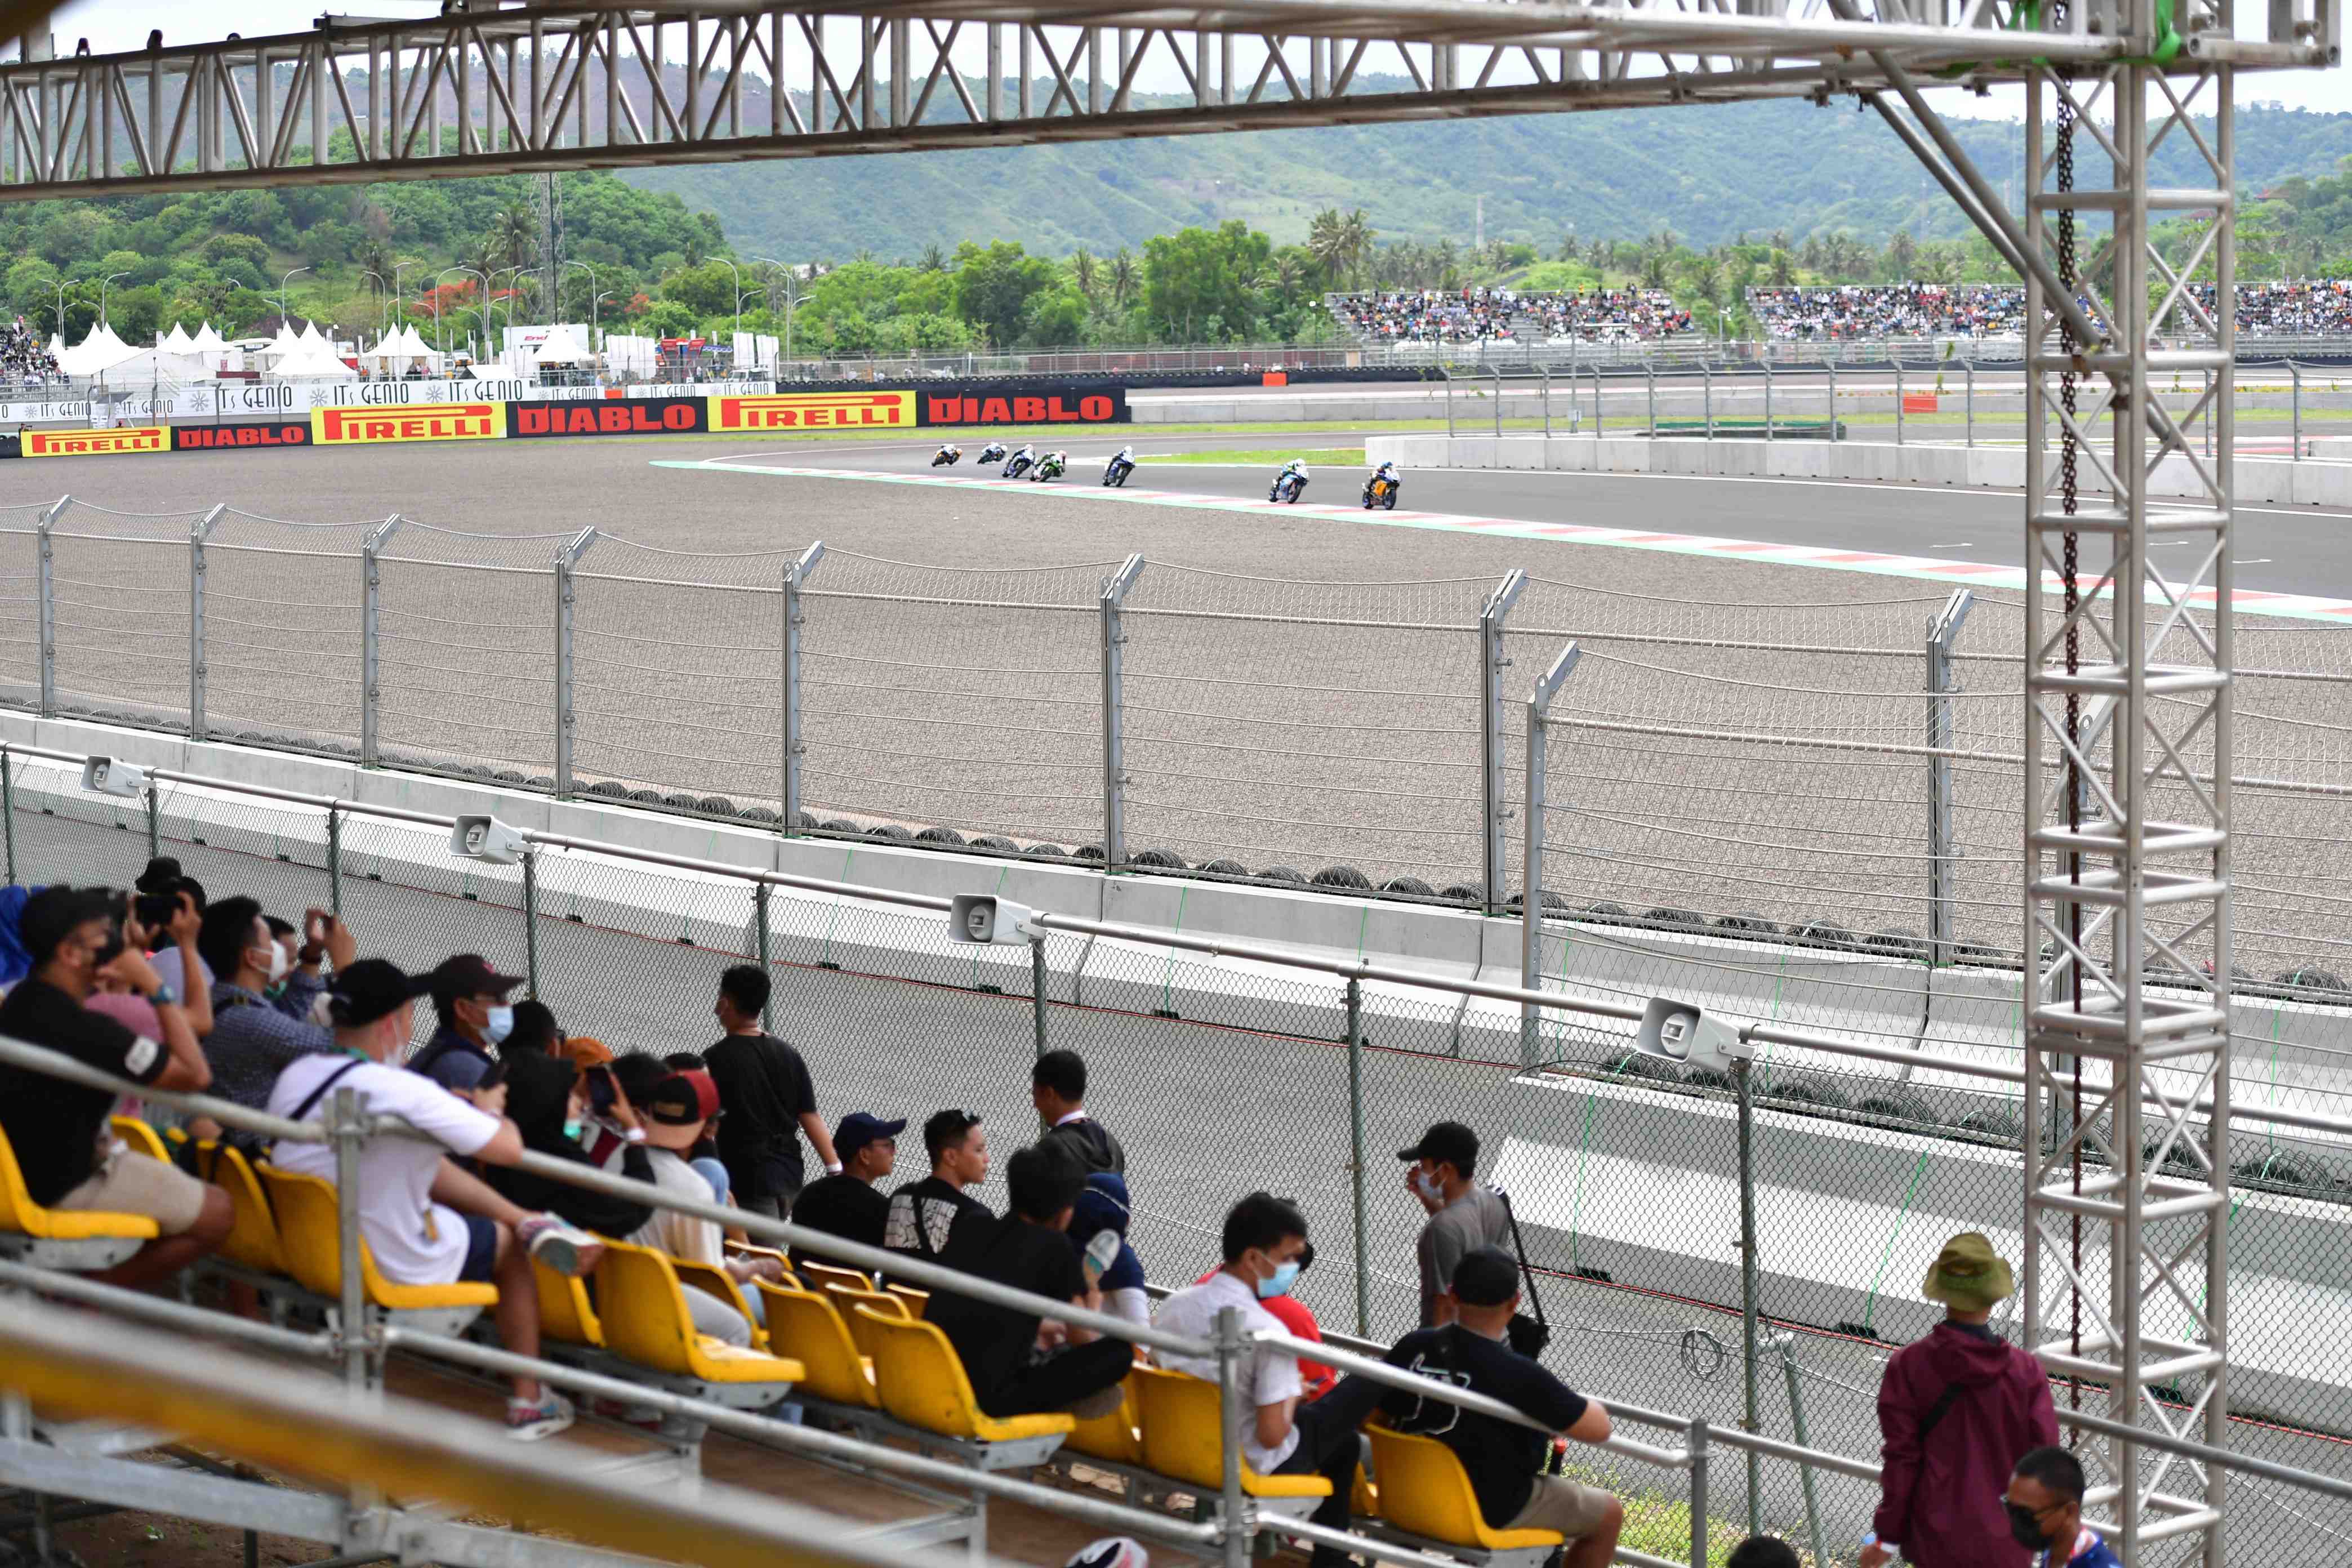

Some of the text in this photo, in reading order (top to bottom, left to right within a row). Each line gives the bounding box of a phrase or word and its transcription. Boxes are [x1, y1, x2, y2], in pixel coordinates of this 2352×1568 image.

[362, 383, 409, 404] GENIO
[474, 379, 523, 401] GENIO
[517, 402, 696, 434] DIABLO
[721, 394, 902, 427] PIRELLI
[928, 392, 1113, 423] DIABLO
[323, 405, 493, 440] PIRELLI
[32, 429, 161, 453] PIRELLI
[178, 426, 305, 448] DIABLO
